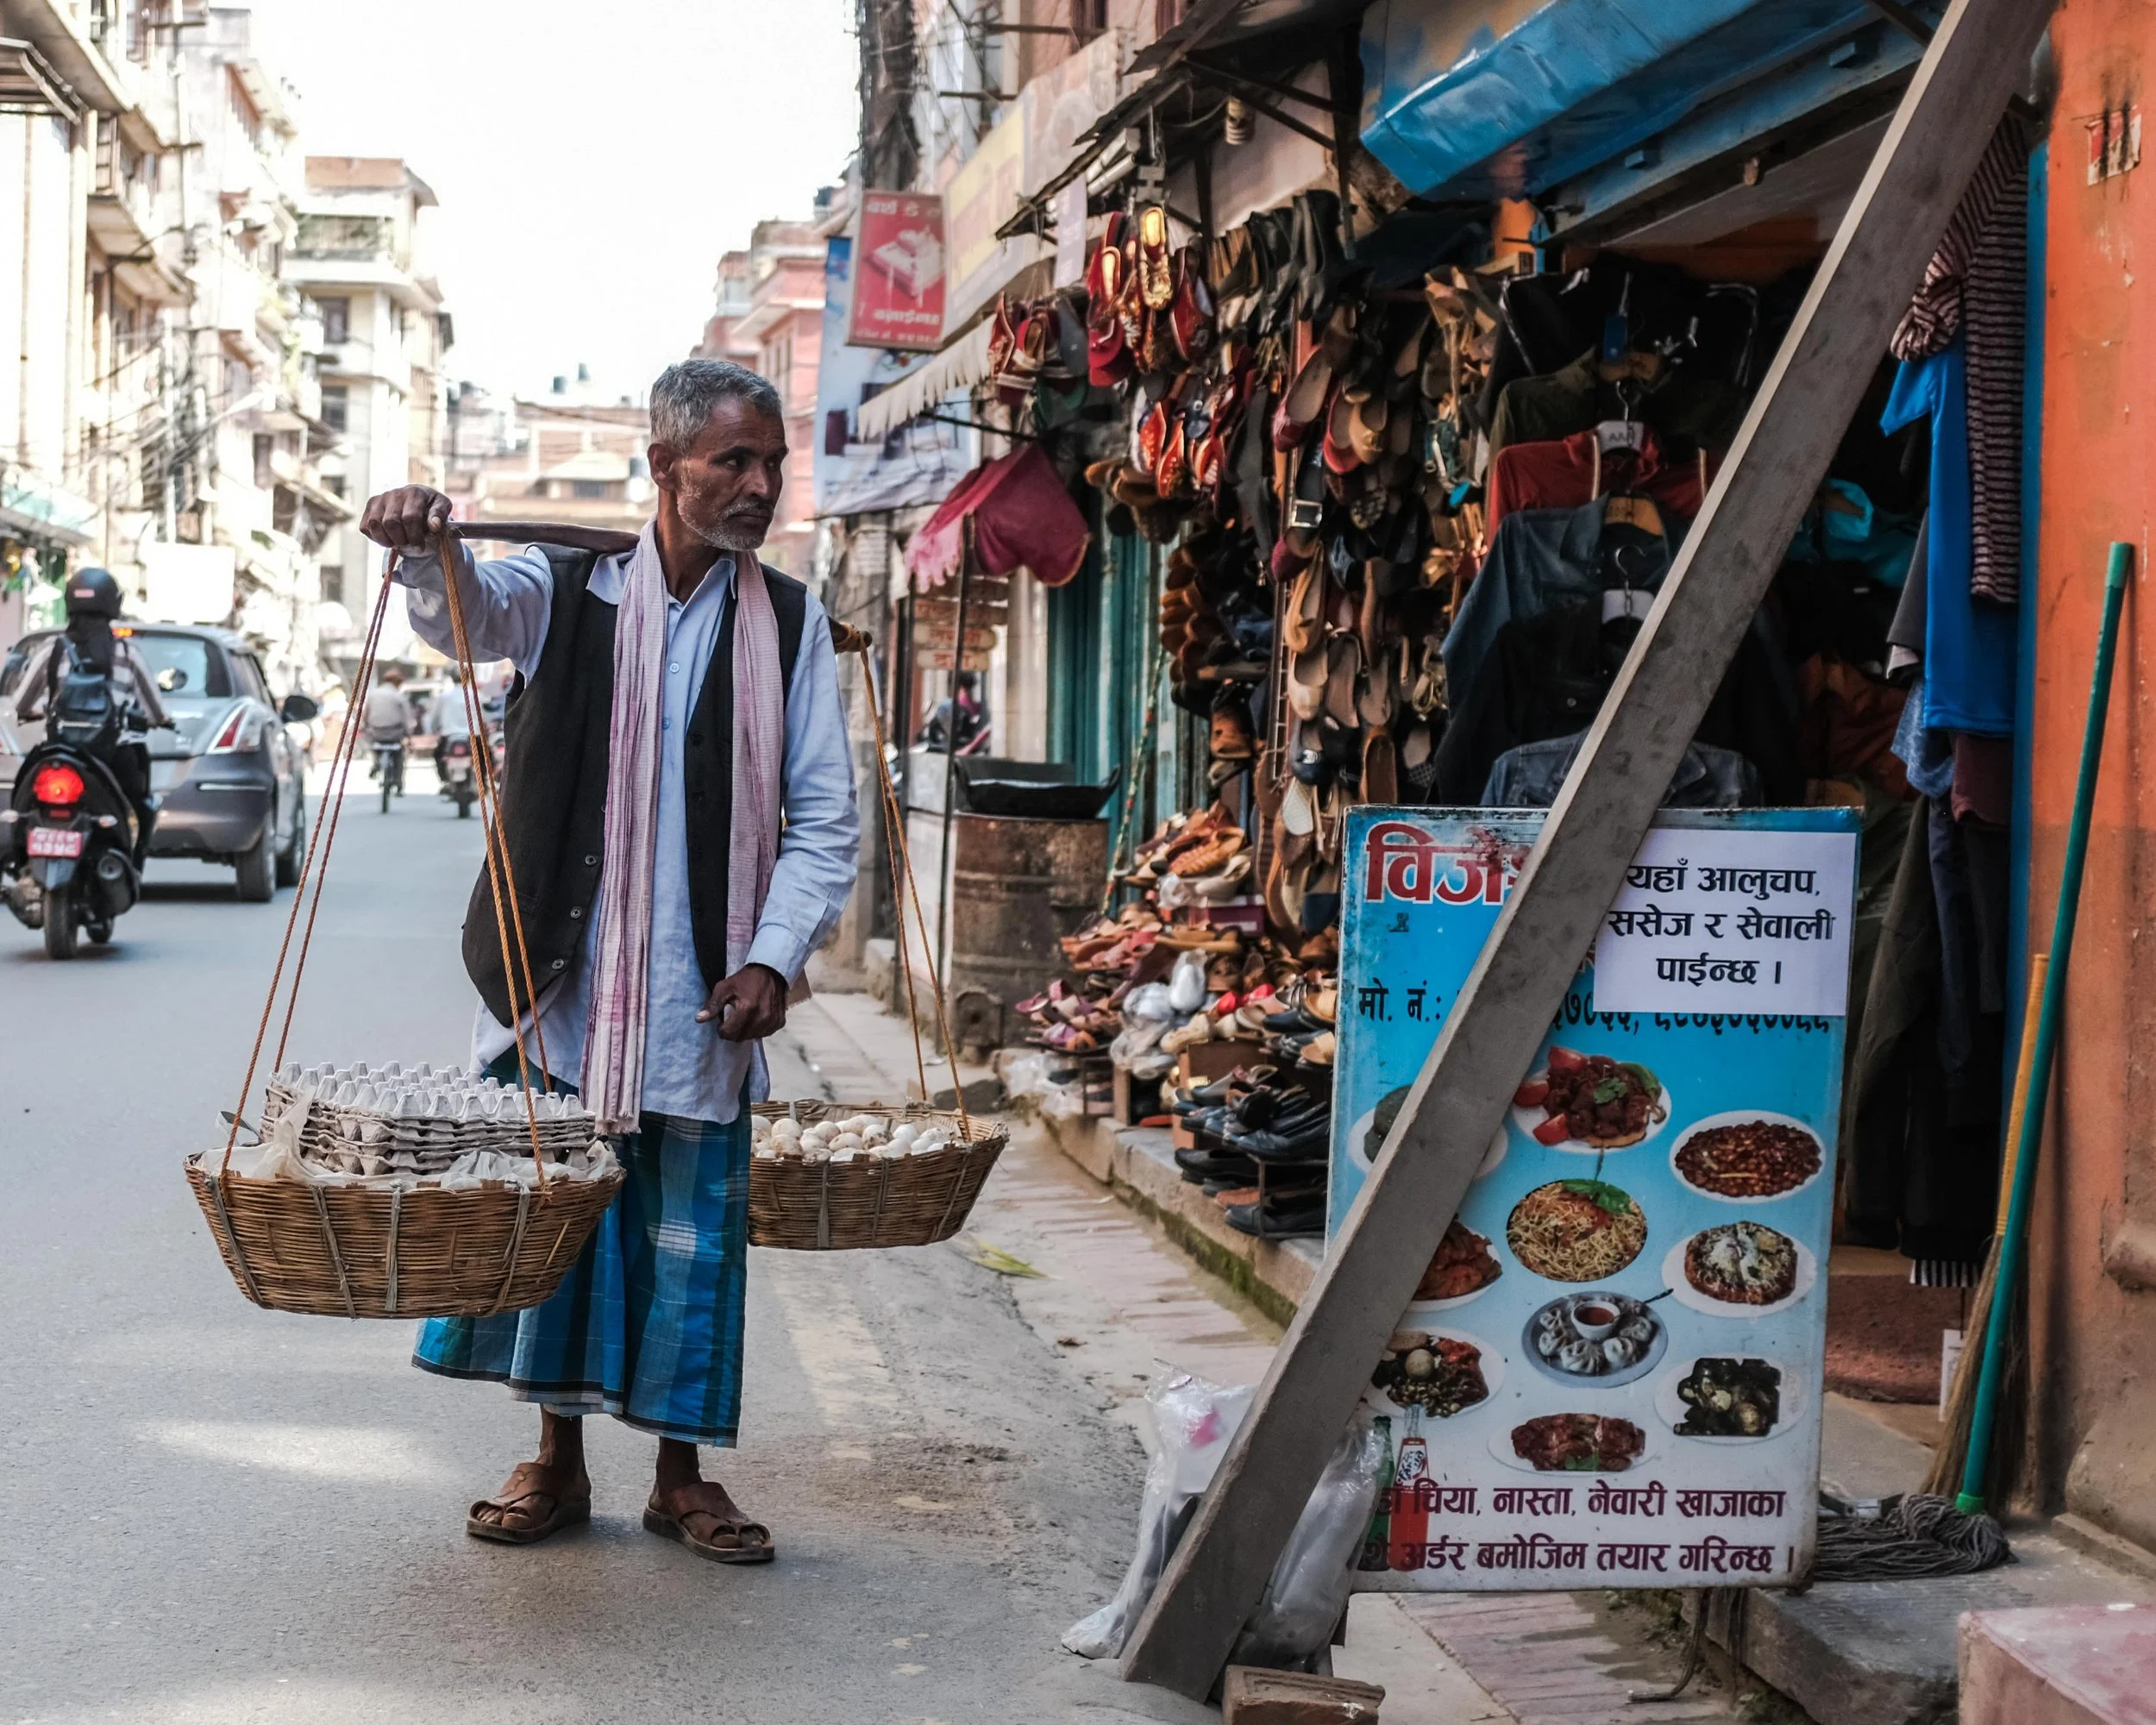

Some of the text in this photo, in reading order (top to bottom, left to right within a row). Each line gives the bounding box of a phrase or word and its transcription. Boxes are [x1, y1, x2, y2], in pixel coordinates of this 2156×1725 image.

[1626, 857, 1821, 900] यहाँ आलुचप,
[1608, 903, 1695, 938] ससेज
[1704, 913, 1727, 938] र
[1656, 952, 1760, 987] पाईन्छ
[1358, 977, 1393, 1022] मो.
[1413, 1477, 1481, 1515] चिया,
[1493, 1487, 1576, 1516] नास्ता,
[1588, 1479, 1667, 1516] नेवारी
[1676, 1490, 1787, 1518] खाजाका
[1401, 1534, 1470, 1571] अर्डर
[1476, 1534, 1589, 1570] बमोजिम
[1596, 1543, 1670, 1572] तयार
[1679, 1534, 1775, 1574] गरिन्छ
